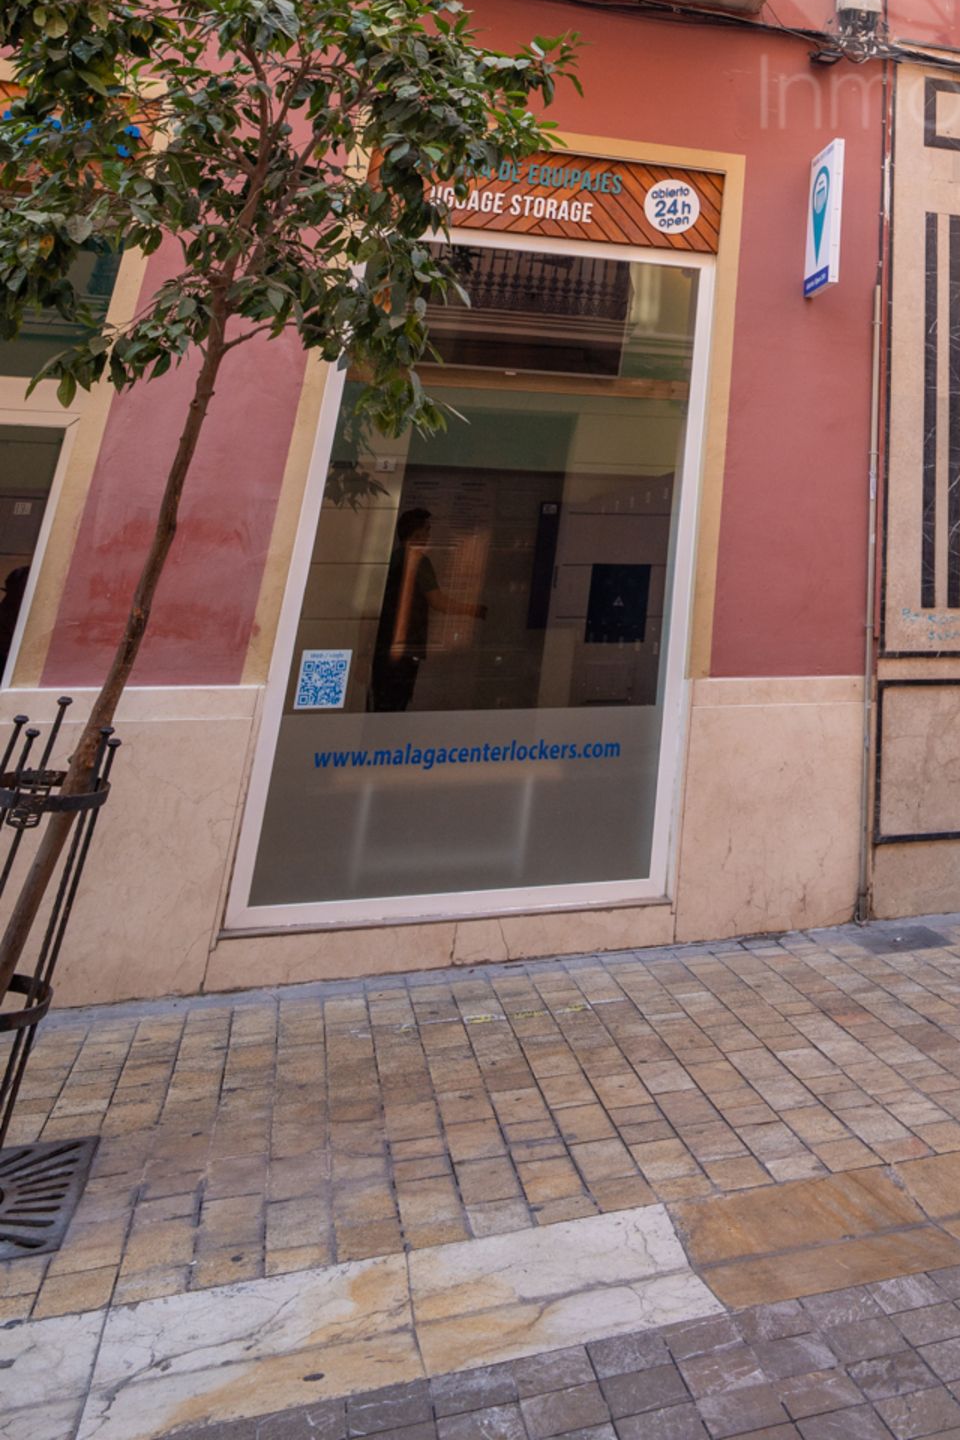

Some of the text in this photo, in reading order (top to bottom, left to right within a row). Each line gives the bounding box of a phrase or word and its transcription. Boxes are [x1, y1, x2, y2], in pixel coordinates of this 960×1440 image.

[528, 163, 623, 194] EQUIPAJES
[651, 186, 690, 199] abierto
[510, 194, 594, 224] STORAGE
[654, 199, 678, 217] 24
[659, 216, 689, 229] open
[314, 739, 621, 770] www.malagacenterlockers.com
